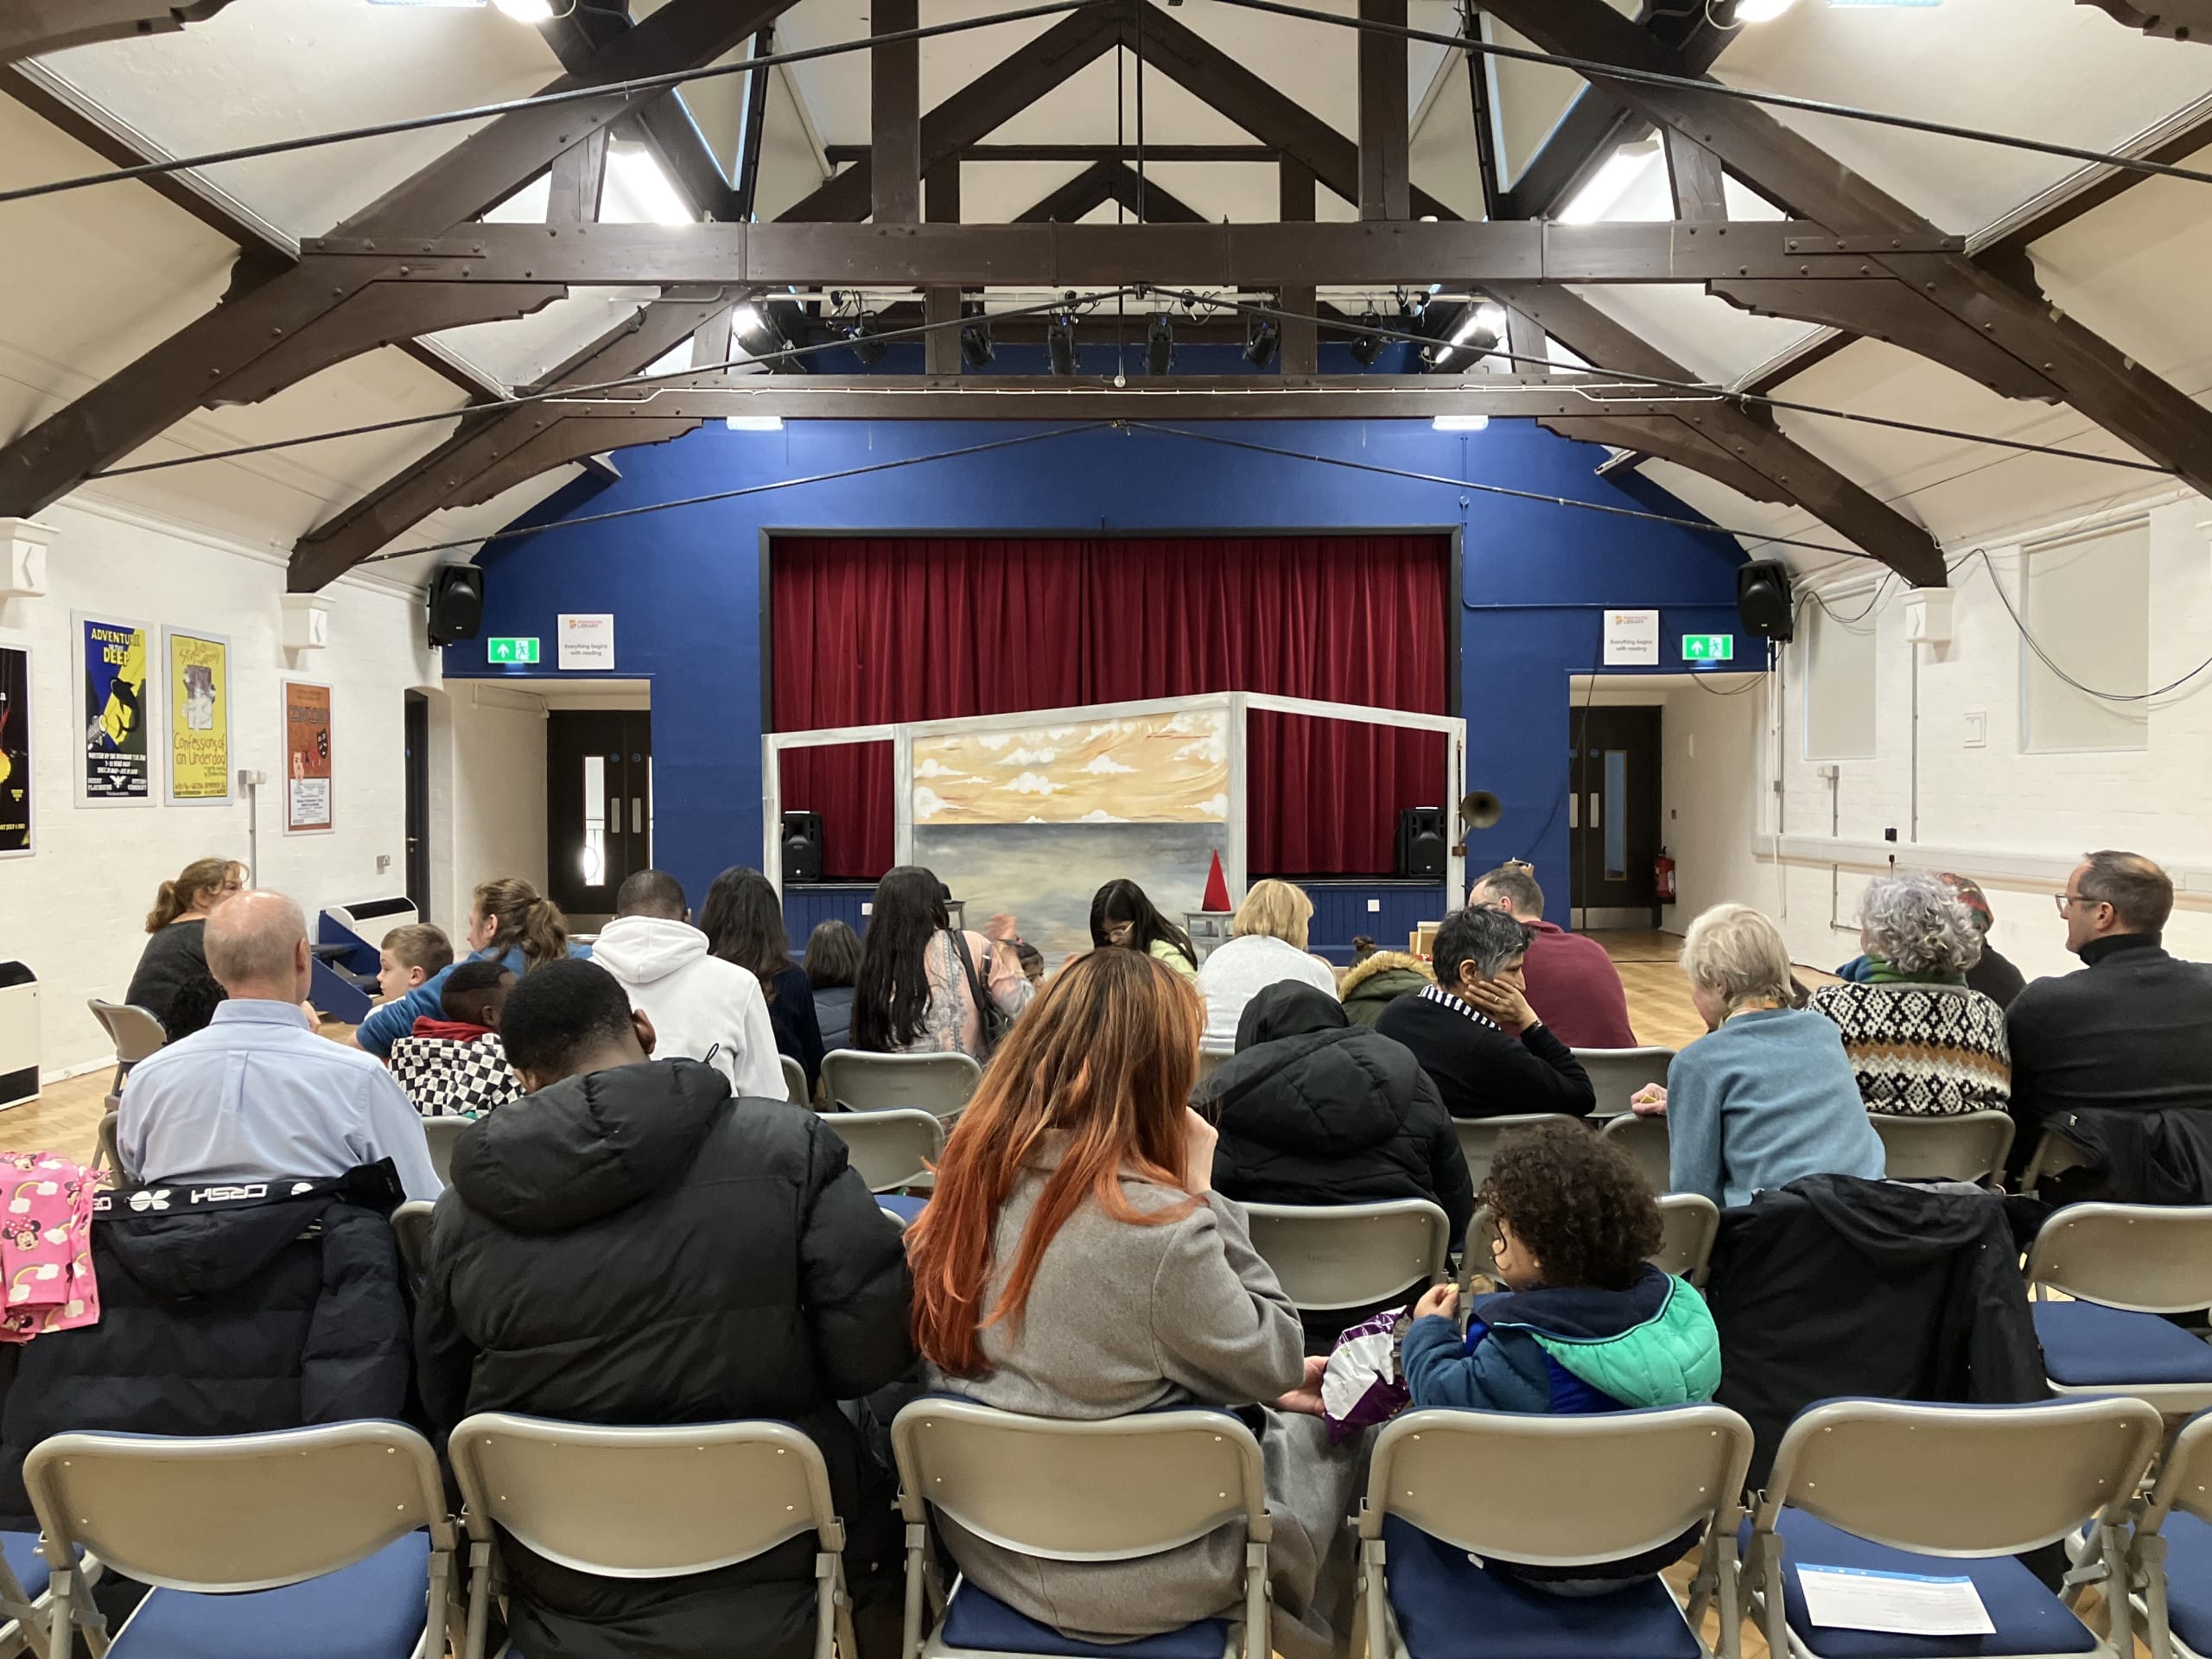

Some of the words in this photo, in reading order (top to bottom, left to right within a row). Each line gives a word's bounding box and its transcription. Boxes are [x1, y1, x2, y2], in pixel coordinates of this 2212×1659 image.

[104, 647, 130, 666] DEEP
[175, 732, 217, 751] Confessions
[219, 734, 225, 752] of
[176, 753, 186, 765] an
[189, 753, 226, 766] Underdog
